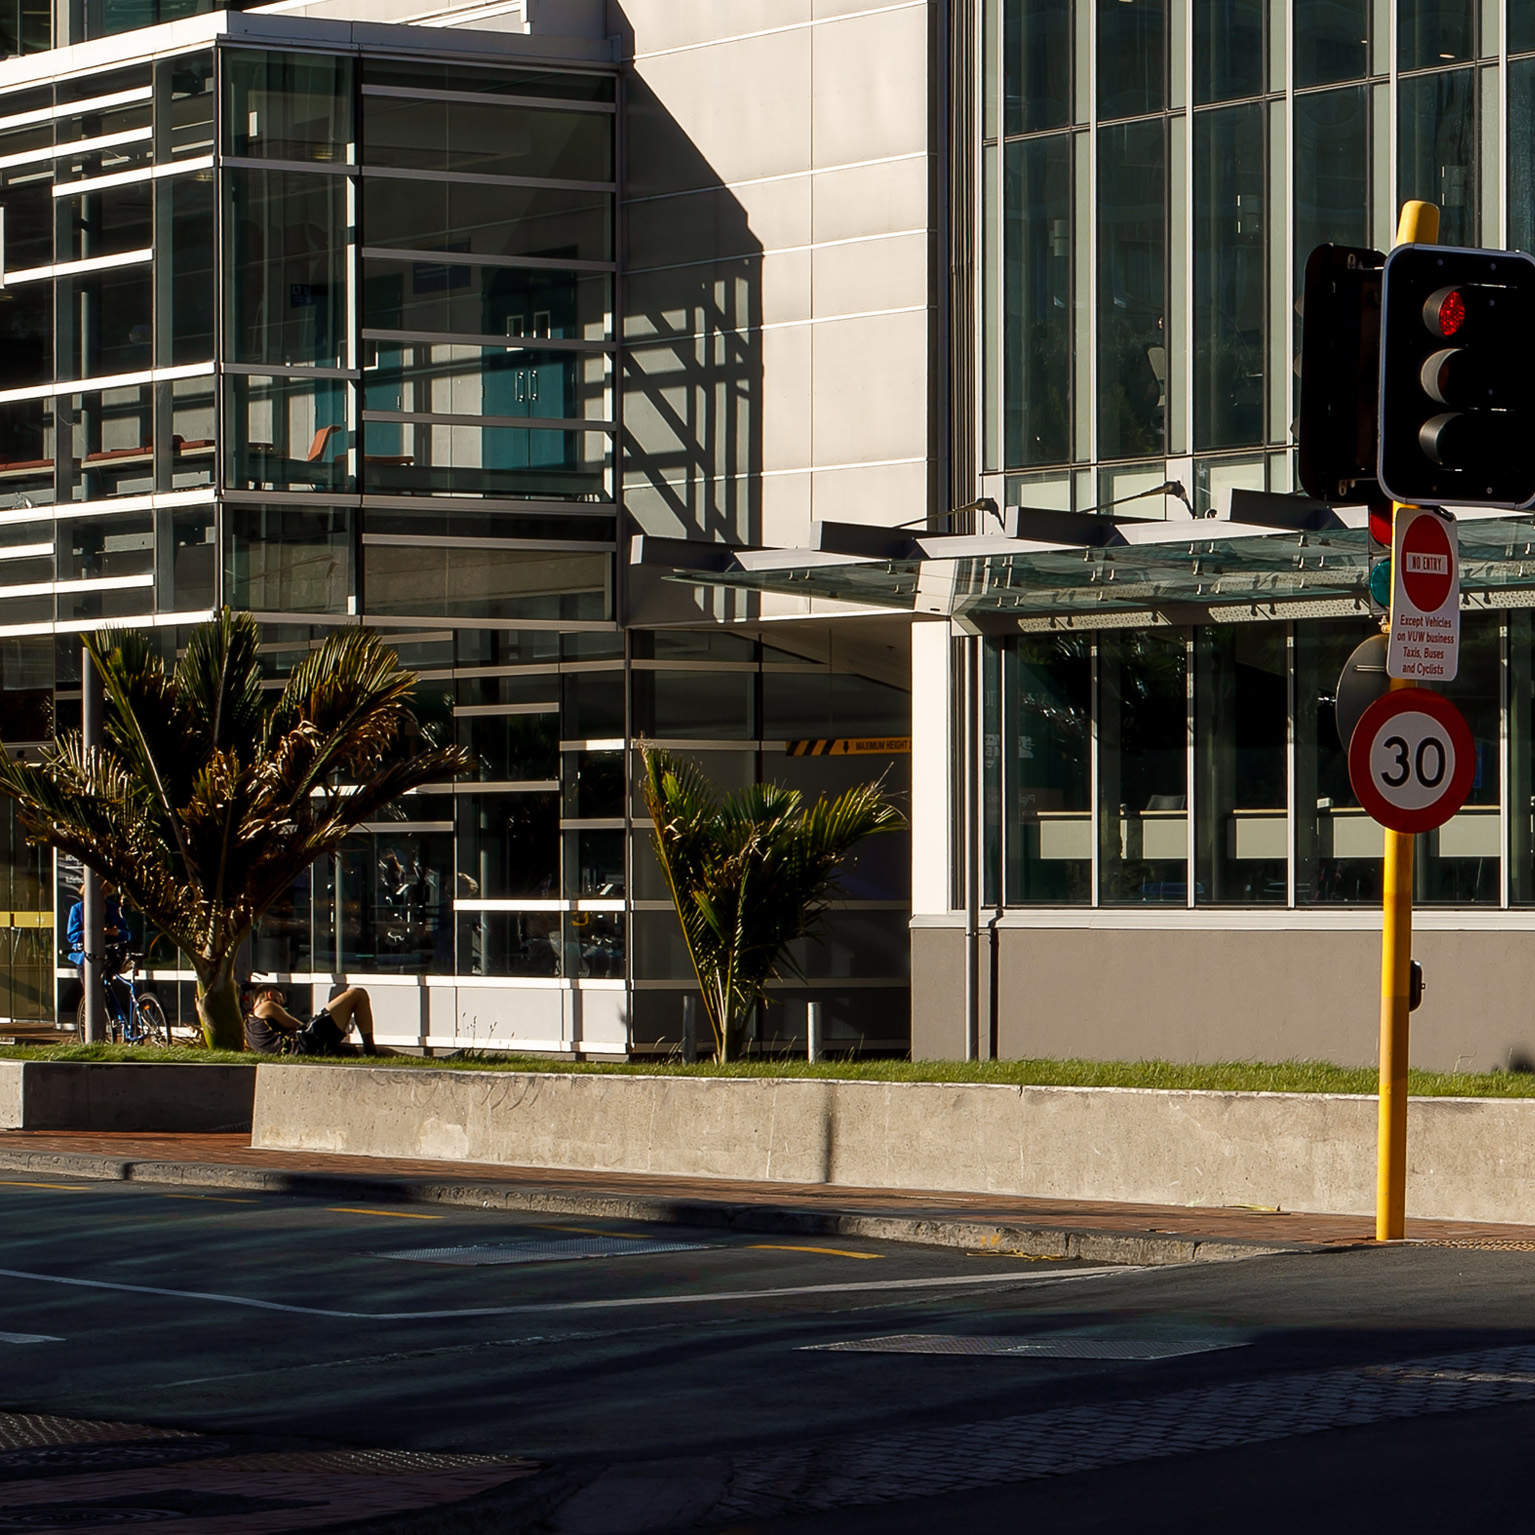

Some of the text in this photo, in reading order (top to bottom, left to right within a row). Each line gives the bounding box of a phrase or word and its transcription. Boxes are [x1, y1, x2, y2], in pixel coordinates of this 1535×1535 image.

[1412, 556, 1442, 571] NO ENTRY
[1400, 615, 1452, 628] Except Vehicles
[1396, 631, 1455, 644] on VUW business
[1403, 646, 1445, 659] Taxis, Buses
[1402, 663, 1444, 676] and Cyclists
[856, 740, 908, 751] MAXIMUM HEIGHT
[1381, 735, 1446, 789] 30
